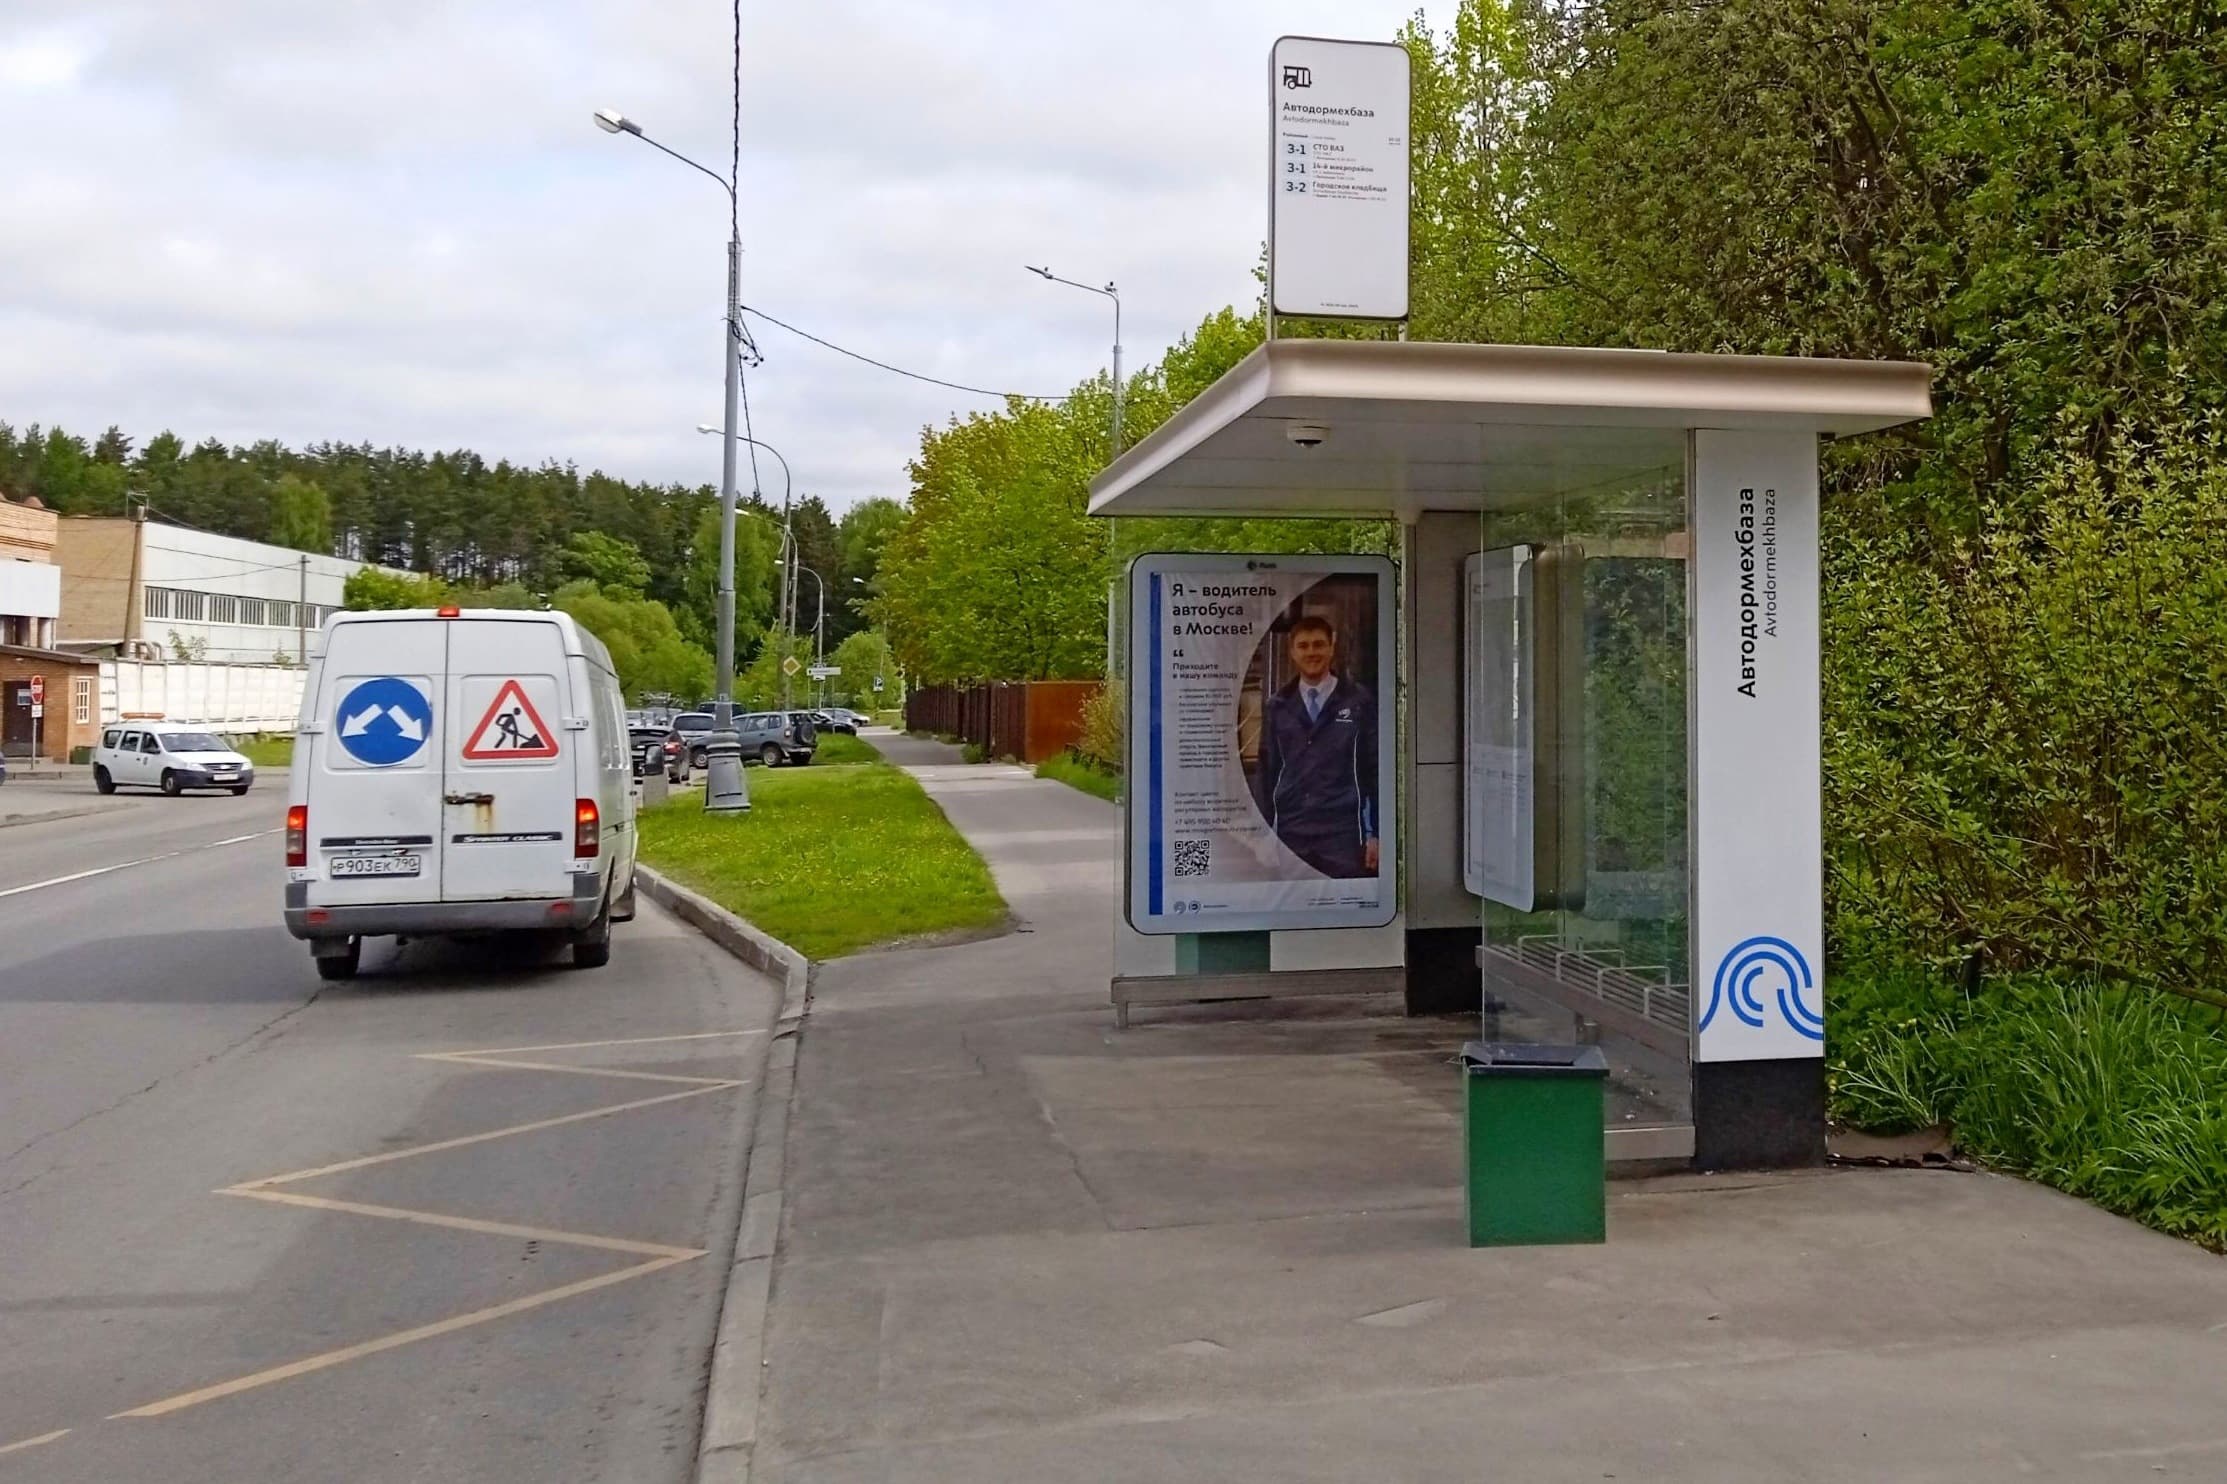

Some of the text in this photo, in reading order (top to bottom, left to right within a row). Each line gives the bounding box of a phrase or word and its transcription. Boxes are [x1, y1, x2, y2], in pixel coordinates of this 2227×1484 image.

[1283, 102, 1375, 117] Автодормехбаза
[1312, 143, 1328, 151] СТО
[1763, 488, 1777, 637] Avtodormekhbaza
[1172, 583, 1184, 597] Я
[1202, 585, 1277, 598] водитель
[1735, 488, 1759, 698] Автодормехбаза
[1172, 602, 1243, 618] автобуса
[1173, 622, 1253, 635] в Москве!
